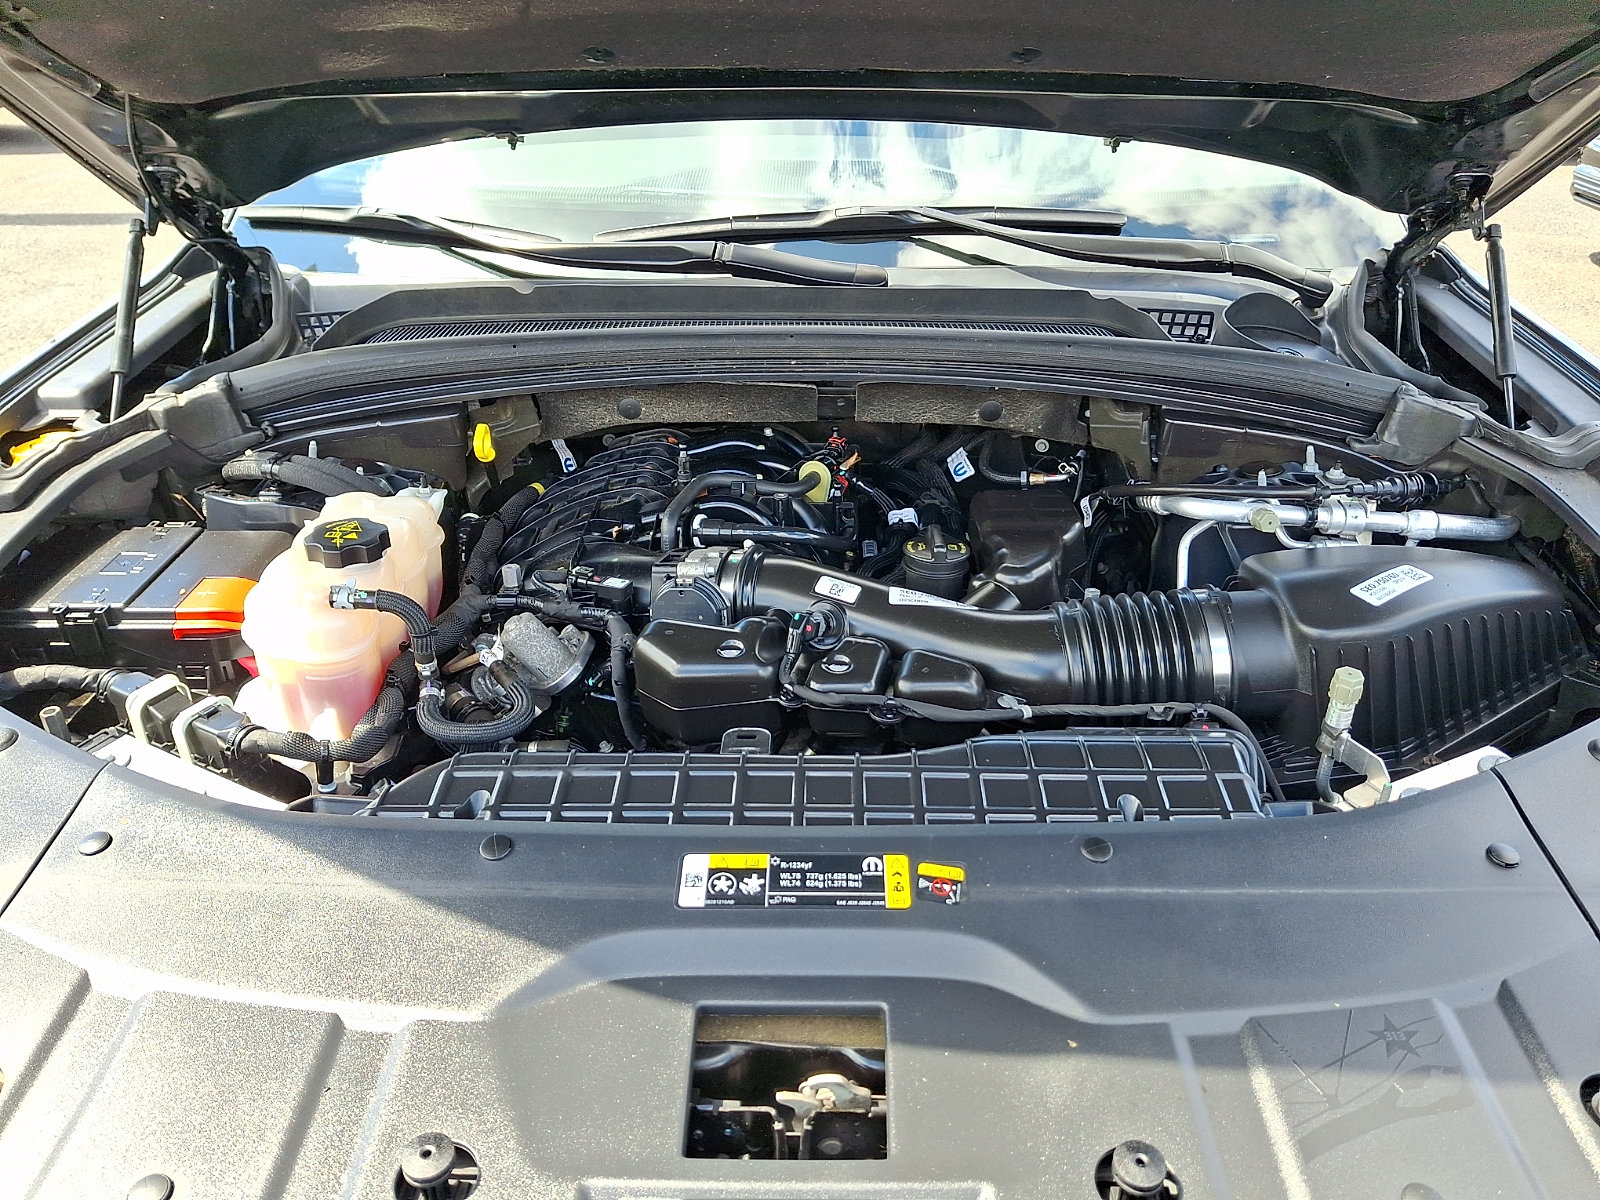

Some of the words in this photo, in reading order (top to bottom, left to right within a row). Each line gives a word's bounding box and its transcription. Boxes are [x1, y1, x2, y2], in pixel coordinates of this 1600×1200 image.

[780, 862, 813, 870] R-1234yf
[805, 872, 824, 881] 737g
[848, 872, 862, 881] lbs)
[848, 880, 862, 888] lbs)
[1383, 1031, 1407, 1041] 313
